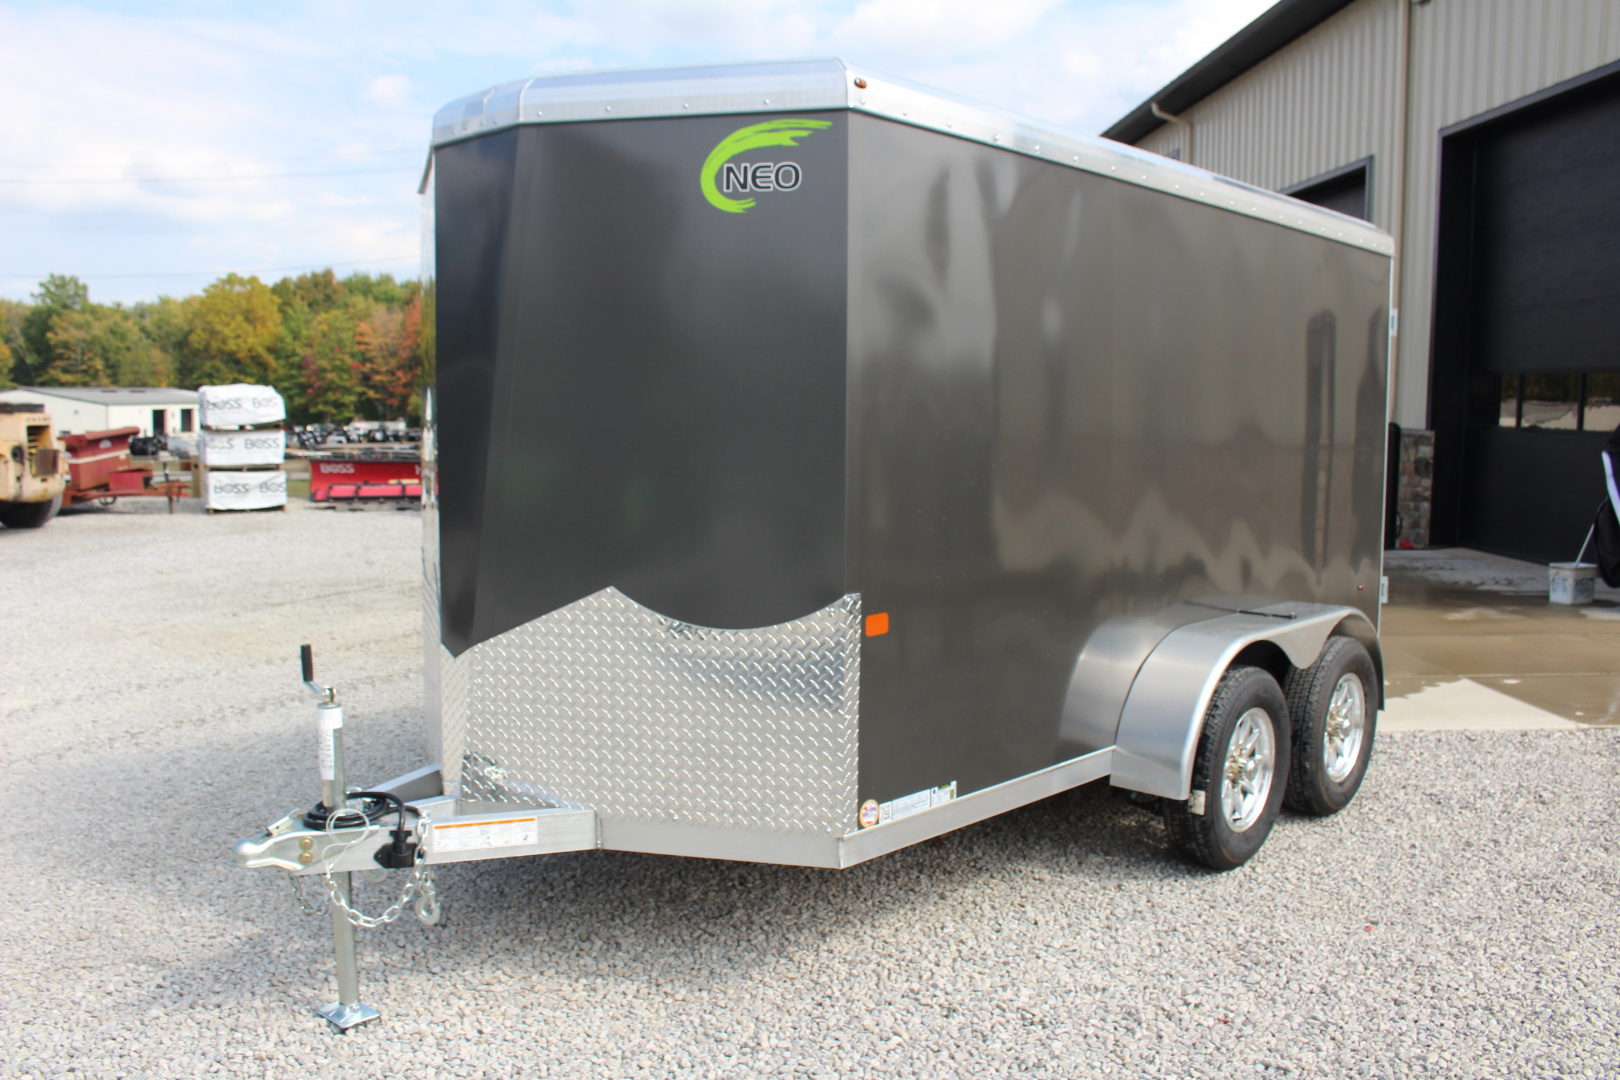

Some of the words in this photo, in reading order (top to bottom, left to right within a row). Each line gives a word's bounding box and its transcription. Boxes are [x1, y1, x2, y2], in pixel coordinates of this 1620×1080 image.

[723, 161, 802, 193] NEO
[244, 437, 280, 450] BOSS
[320, 463, 356, 474] BOSS
